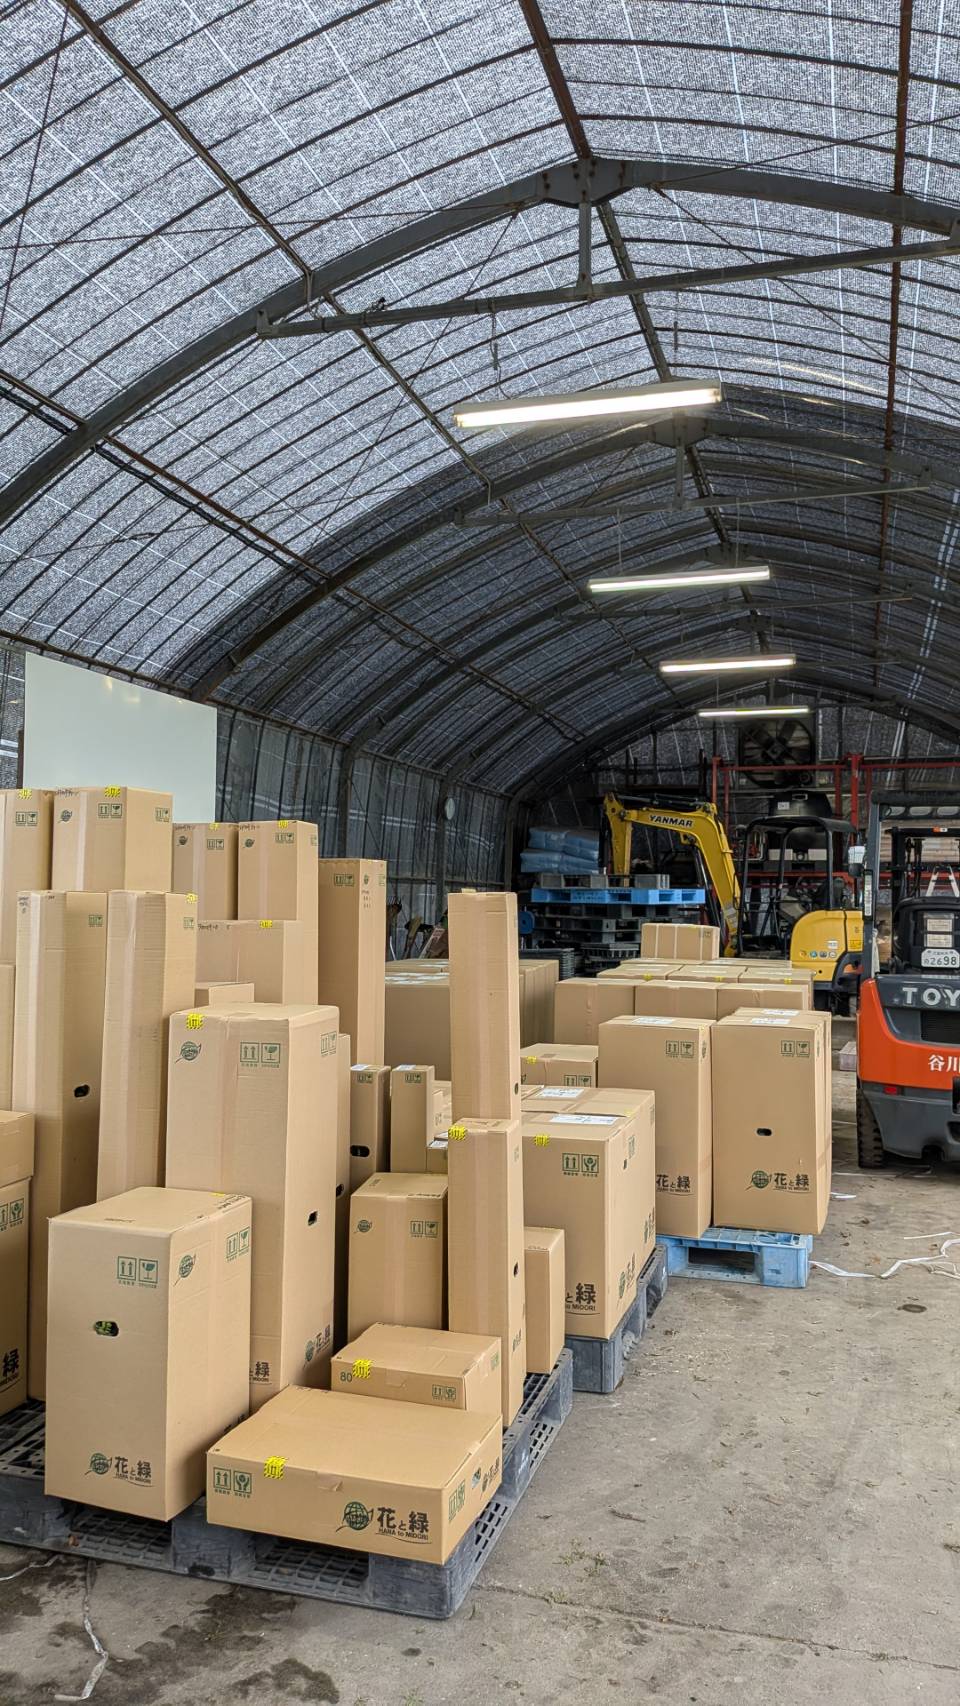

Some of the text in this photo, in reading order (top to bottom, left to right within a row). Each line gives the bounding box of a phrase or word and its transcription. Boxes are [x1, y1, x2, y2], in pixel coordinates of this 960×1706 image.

[649, 814, 693, 828] YANMAR
[902, 987, 960, 1007] TOY
[928, 1054, 960, 1073] 谷川
[773, 1173, 809, 1187] 花と緑
[565, 1282, 596, 1305] と緑
[340, 1371, 353, 1383] 80
[114, 1456, 152, 1479] 花と緑
[377, 1507, 429, 1533] 花と緑
[405, 1532, 429, 1540] MIDORI
